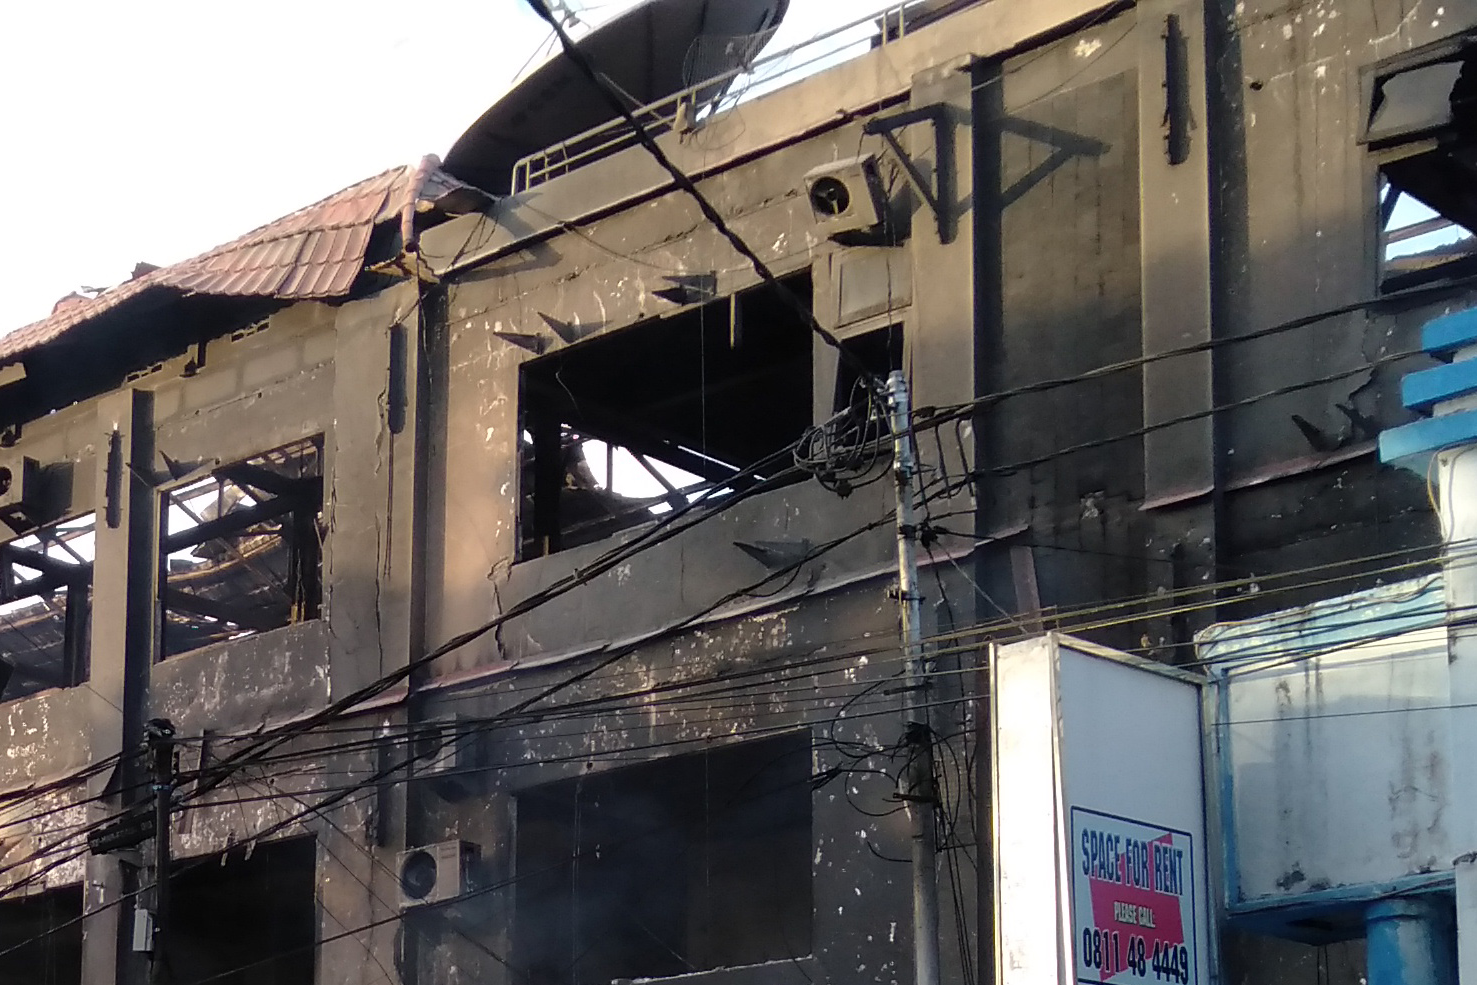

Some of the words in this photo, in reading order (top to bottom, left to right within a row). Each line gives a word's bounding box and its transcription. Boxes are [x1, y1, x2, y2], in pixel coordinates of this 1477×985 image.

[1081, 828, 1122, 883] SPACE
[1125, 837, 1150, 889] FOR
[1154, 843, 1183, 896] RENT
[1113, 900, 1137, 925] PLEASE
[1082, 926, 1121, 973] 0811
[1127, 934, 1146, 978] 48
[1152, 938, 1189, 985] 4449
